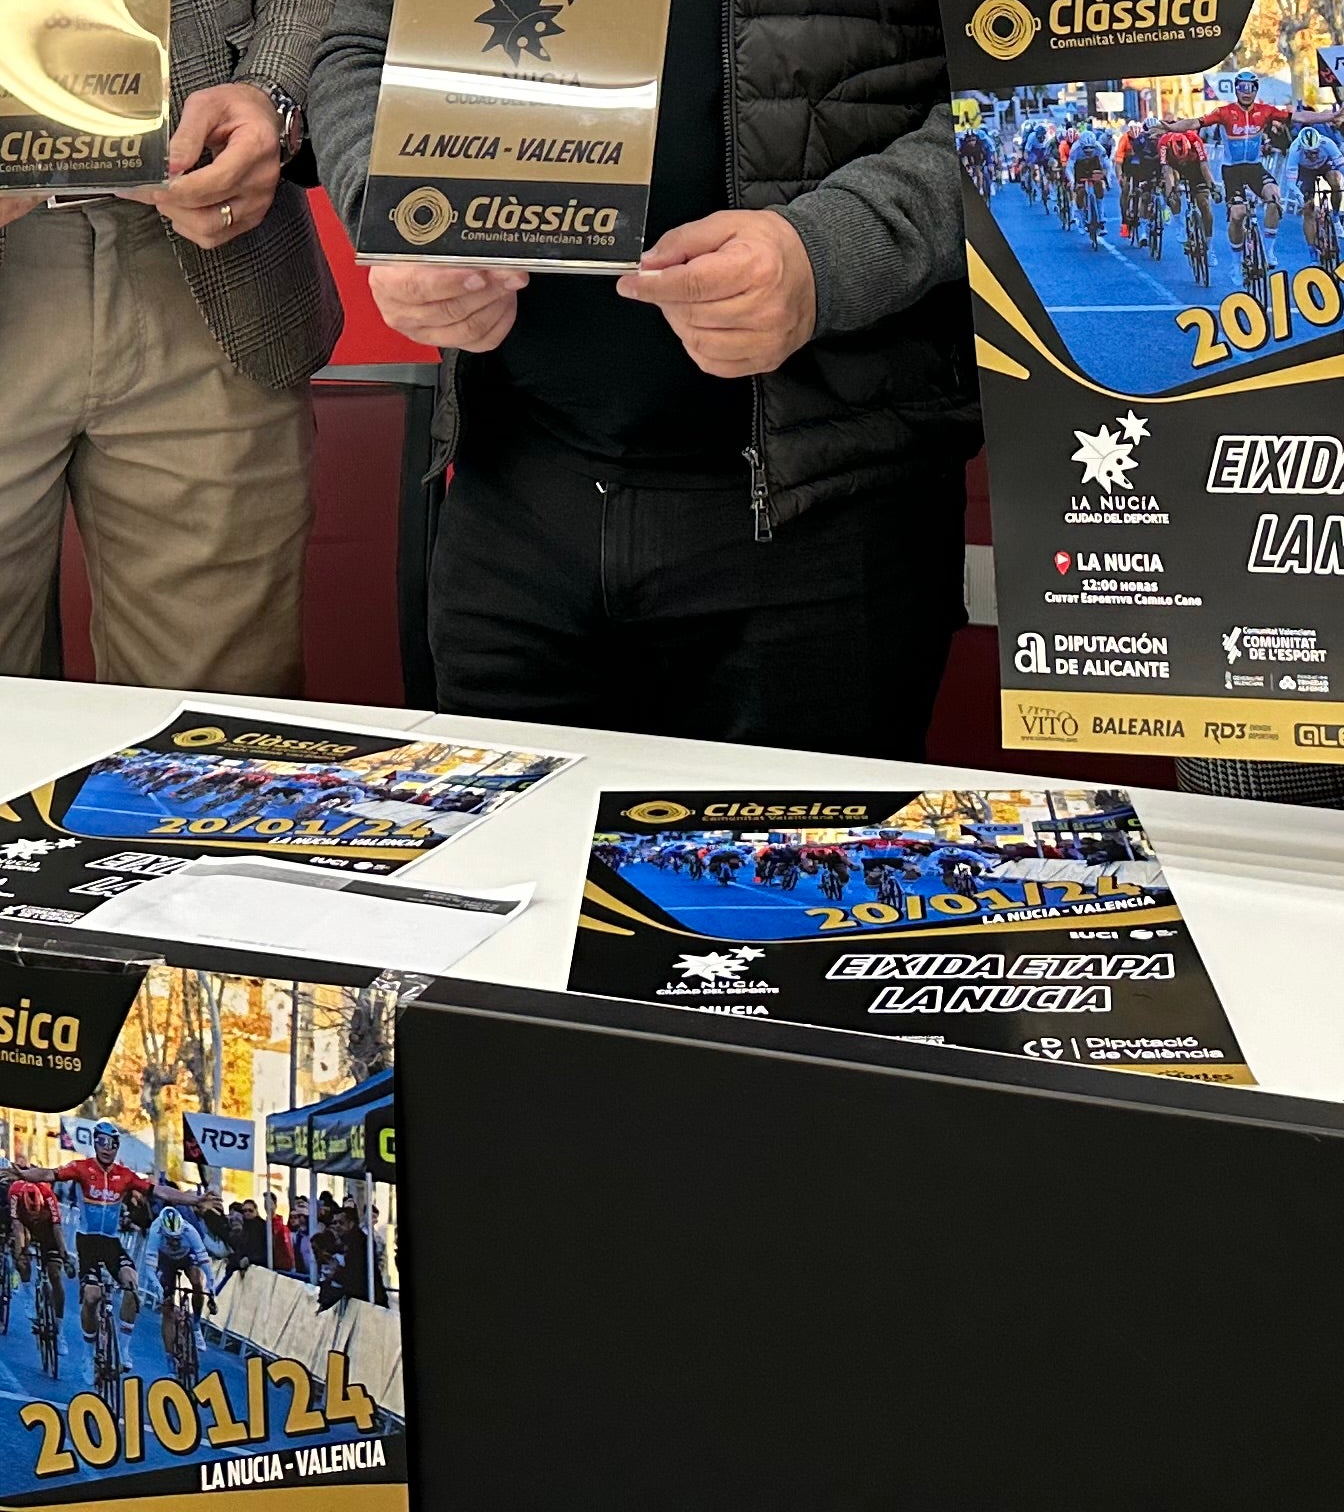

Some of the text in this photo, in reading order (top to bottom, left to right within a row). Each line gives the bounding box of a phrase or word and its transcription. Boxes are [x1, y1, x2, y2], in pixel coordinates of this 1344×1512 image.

[1050, 24, 1222, 50] Comunitat Valenciana 1969
[0, 130, 143, 163] Clàssica
[399, 133, 623, 166] LA NUCIA VALENCIA
[0, 158, 143, 173] Comunitat Valenciana 1969
[464, 193, 619, 234] Clàssica
[460, 229, 616, 246] Comunitat Valenciana 1969
[1071, 496, 1091, 510] LA
[1064, 512, 1170, 525] CIUDAD DEL DEPORTE
[1247, 514, 1314, 574] LA
[1076, 552, 1165, 573] LA NUCIA
[1082, 578, 1118, 592] 12:00
[1054, 633, 1169, 656] DIPUTACIÓN
[1242, 635, 1317, 650] COMUNITAT
[1248, 648, 1328, 663] DE L'ESPORT
[1055, 659, 1170, 679] DE ALICANTE
[233, 733, 358, 754] Clàssica
[1204, 721, 1247, 744] RD3
[703, 802, 867, 817] Clàssica
[147, 816, 435, 839] 20/01/24
[806, 875, 1145, 932] 20/01/24
[982, 894, 1156, 926] LA NUCIA VALENCIA
[824, 952, 1177, 980] EIXIDA ETAPA
[867, 985, 1112, 1013] LA NUCIA
[1086, 1036, 1200, 1049] Diputació
[1090, 1047, 1225, 1060] de València
[47, 1054, 82, 1073] 1969
[201, 1127, 251, 1152] RD3
[19, 1349, 375, 1476] 20/01/24
[200, 1439, 387, 1491] LA NUCIA VALENCIA
